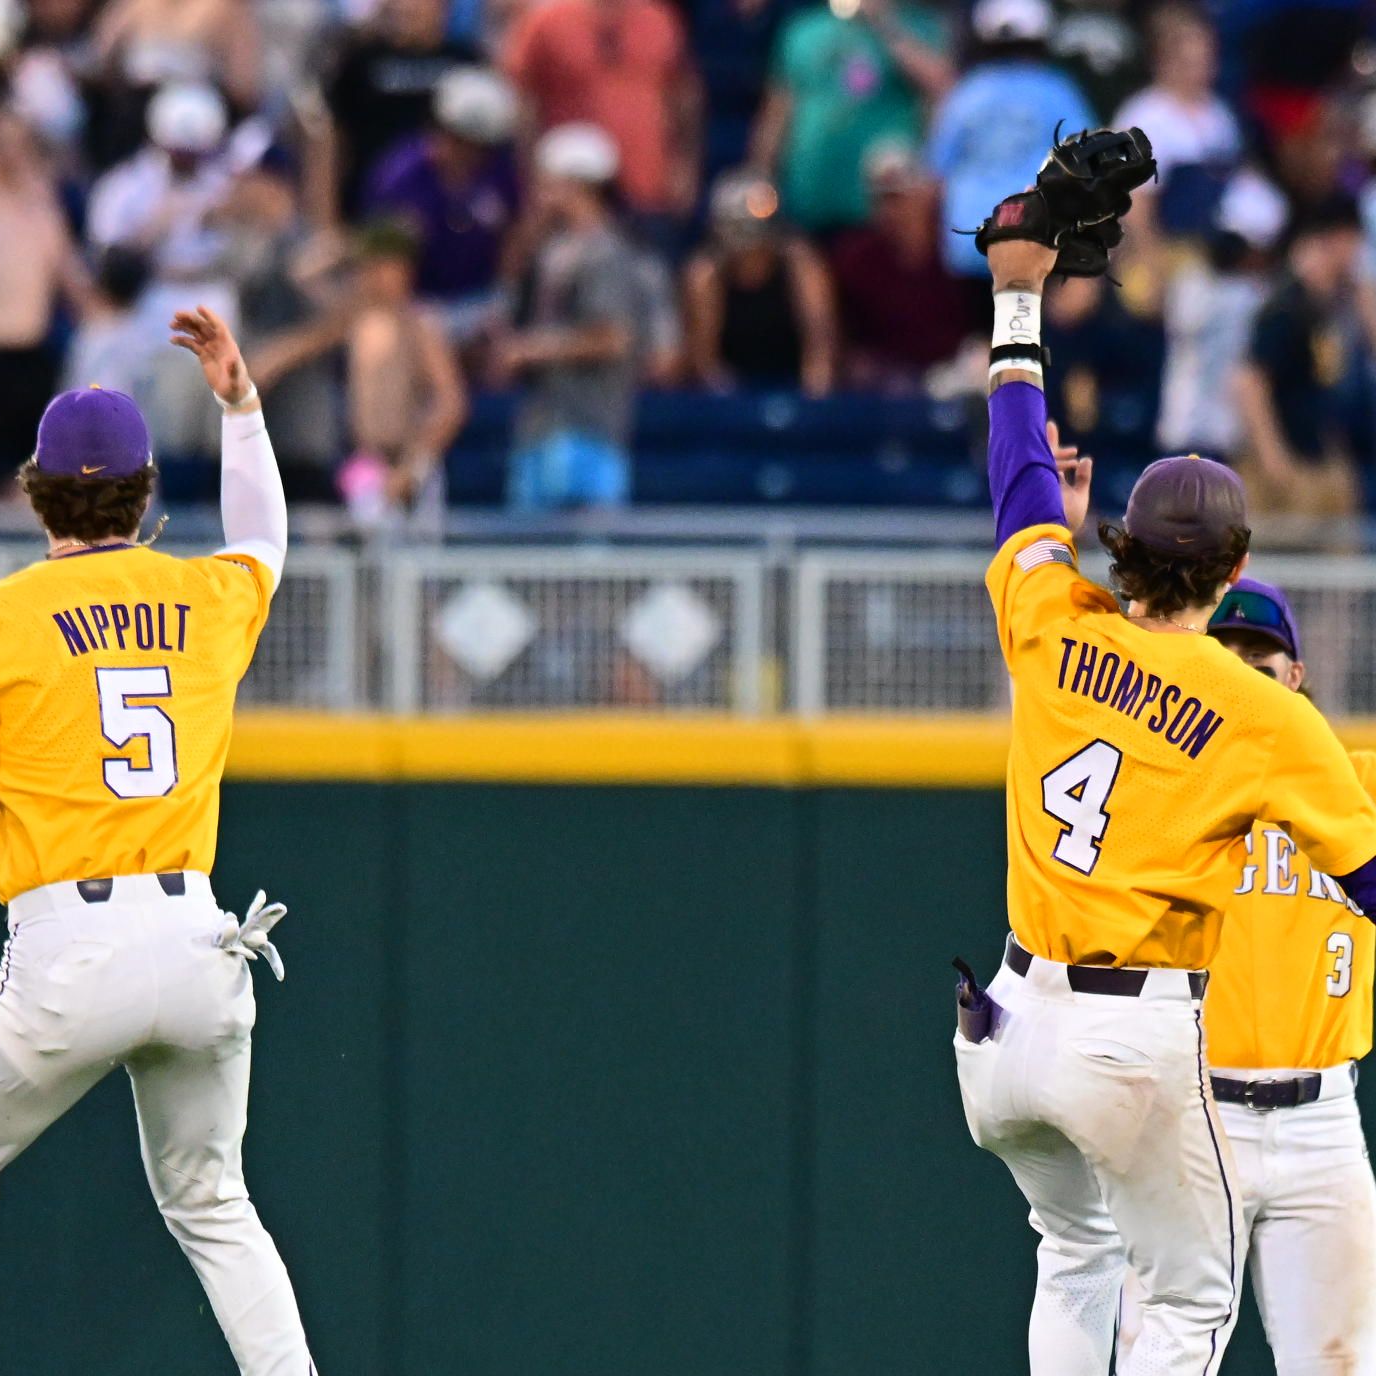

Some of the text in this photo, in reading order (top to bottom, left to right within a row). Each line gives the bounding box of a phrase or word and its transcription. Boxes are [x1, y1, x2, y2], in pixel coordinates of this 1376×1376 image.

[52, 603, 191, 656] NIPPOLT
[95, 665, 179, 799] 5
[1058, 637, 1223, 760] THOMPSON
[1040, 738, 1123, 876] 4
[1326, 932, 1354, 998] 3
